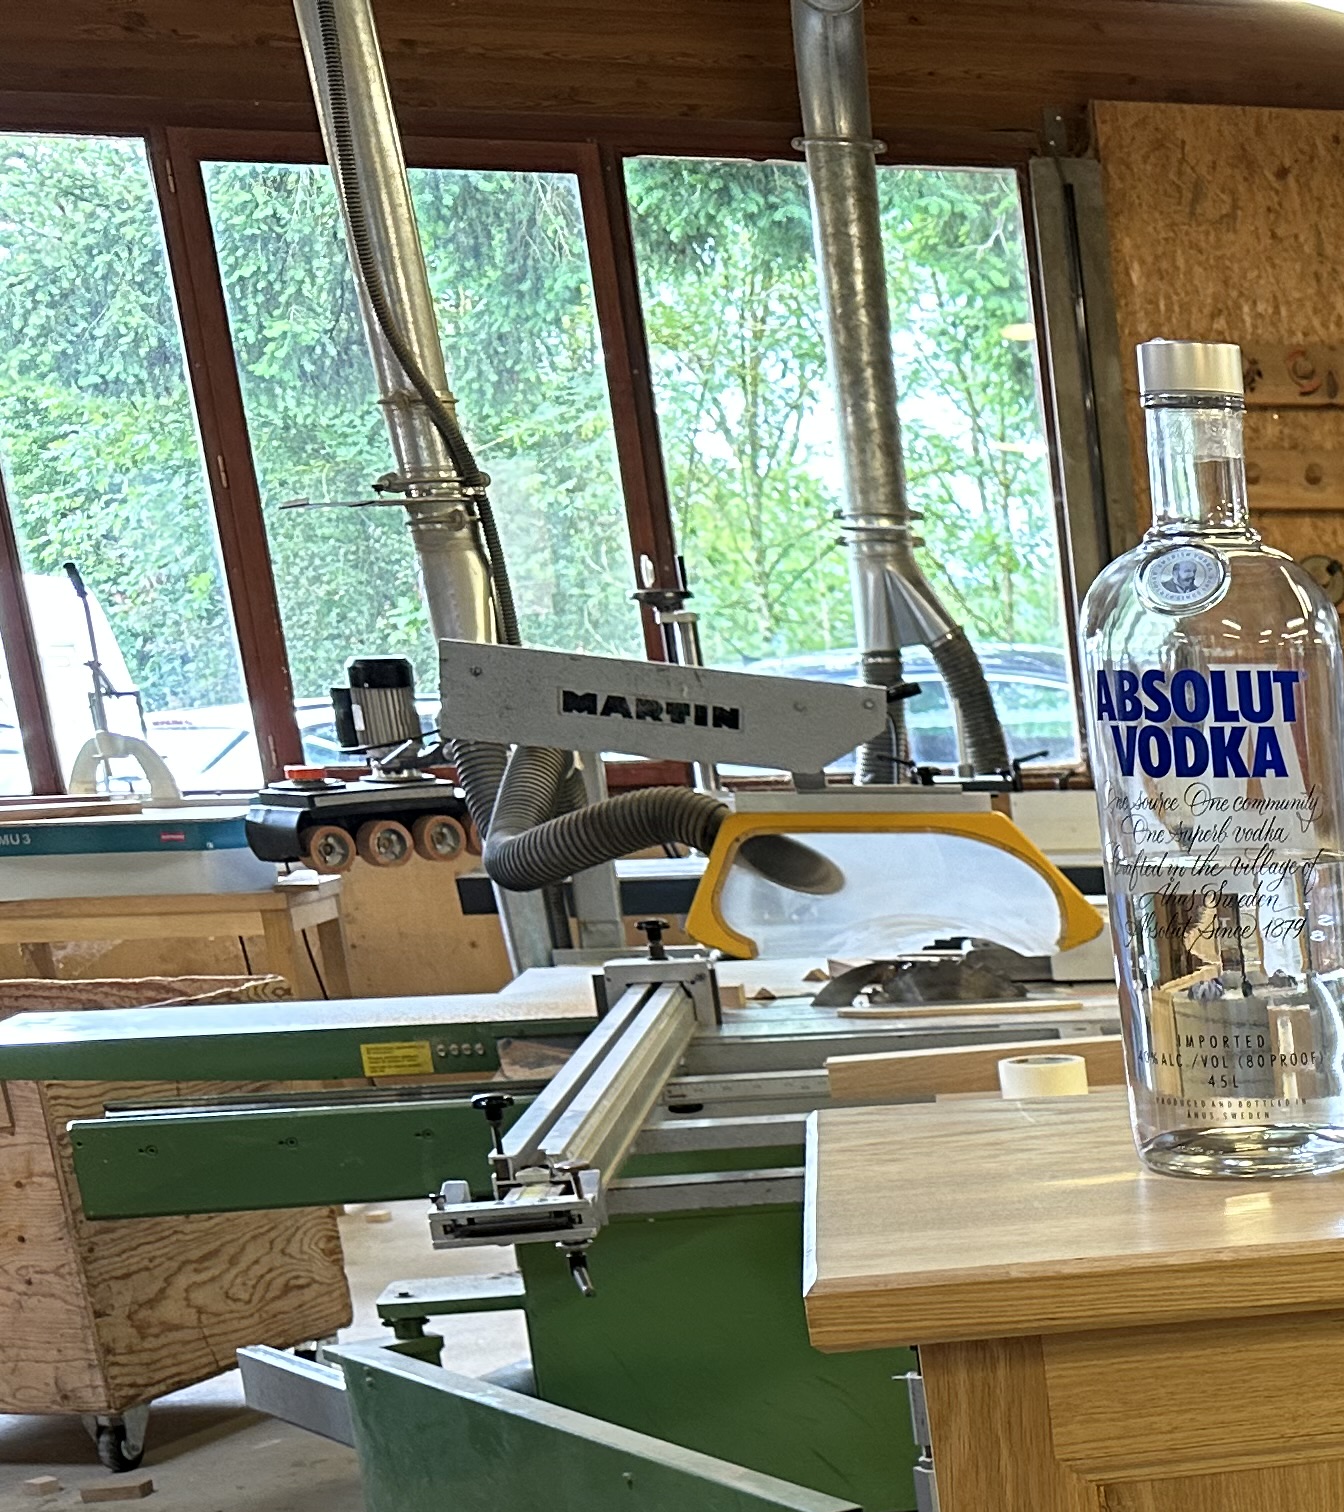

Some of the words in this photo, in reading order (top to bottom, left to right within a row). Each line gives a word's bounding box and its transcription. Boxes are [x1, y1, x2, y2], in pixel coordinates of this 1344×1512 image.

[561, 690, 740, 729] MARTIN
[1096, 669, 1300, 723] ABSOLUT
[1110, 725, 1289, 778] VODKA
[1184, 782, 1229, 816] One
[1232, 784, 1324, 833] community
[1121, 814, 1165, 844] One
[1234, 816, 1289, 843] vodka
[1190, 844, 1226, 877] the
[1263, 917, 1308, 940] 1879
[1176, 1034, 1266, 1049] IMPORTED
[1223, 1111, 1270, 1121] SWEDEN
